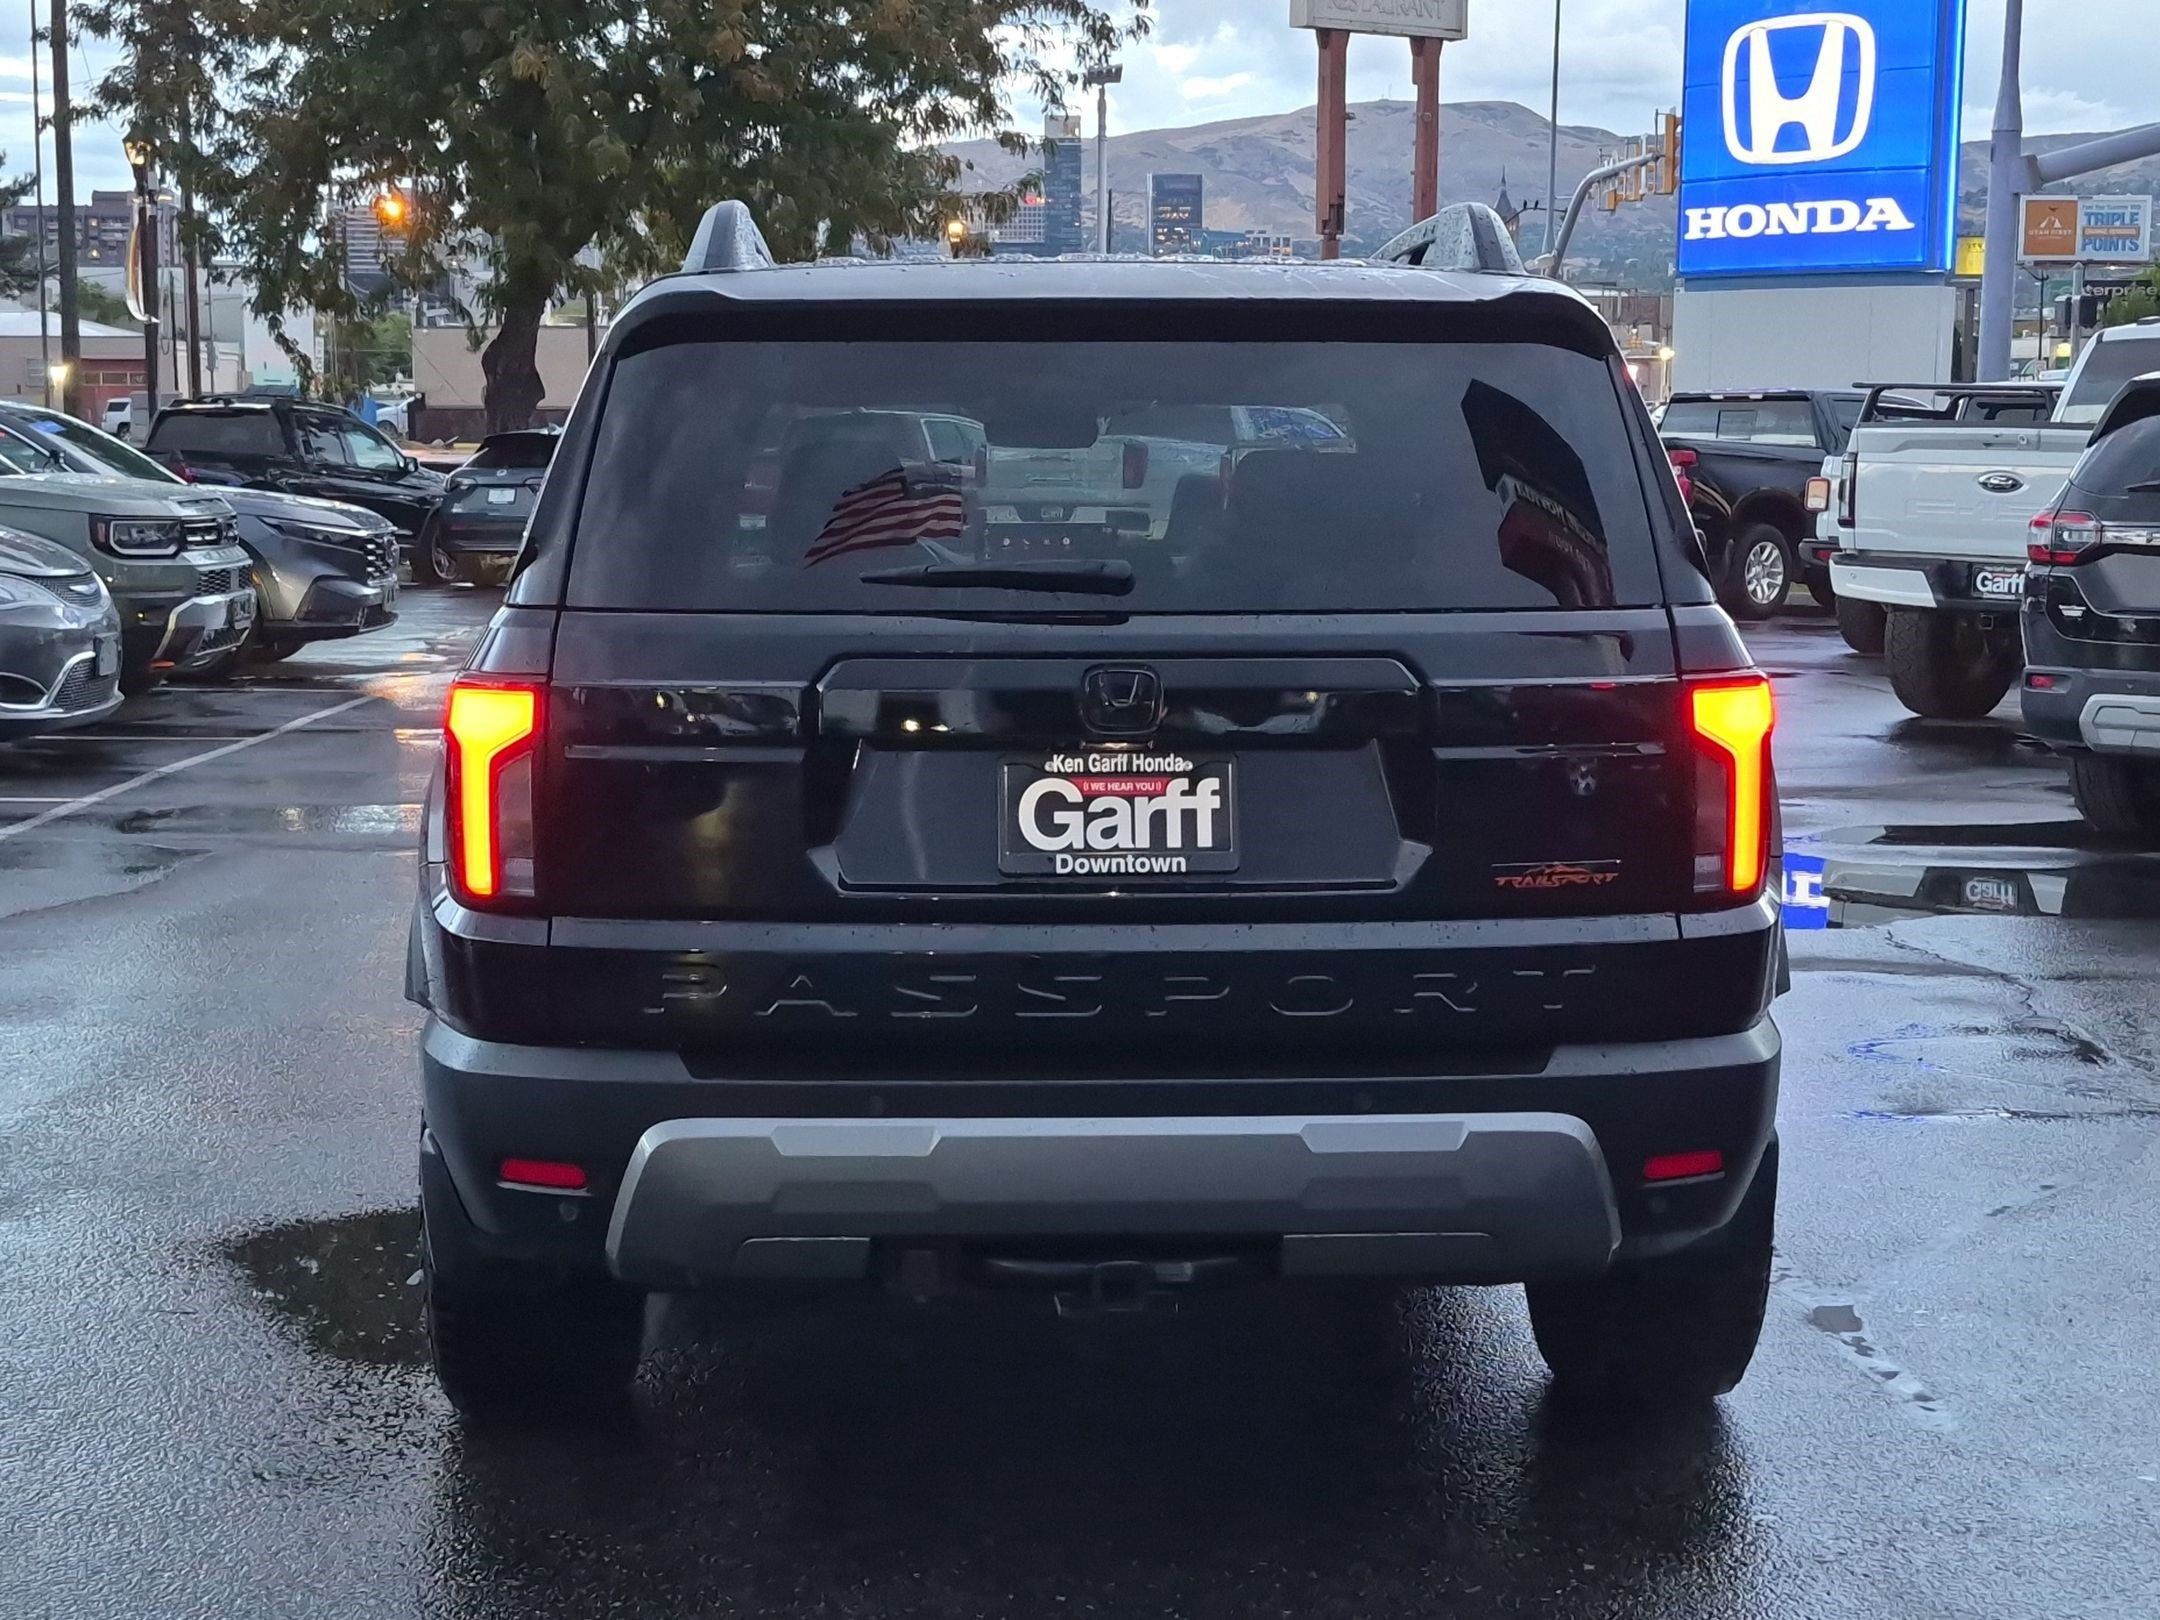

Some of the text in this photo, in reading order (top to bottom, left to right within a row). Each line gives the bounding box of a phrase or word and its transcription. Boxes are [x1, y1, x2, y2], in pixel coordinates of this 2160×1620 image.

[1684, 197, 1915, 240] HONDA
[2084, 211, 2139, 225] TRIPLE
[2081, 238, 2139, 252] POINTS
[1053, 754, 1184, 773] Ken Garff Honda
[1091, 782, 1154, 791] WE HEAR YOU
[1018, 777, 1220, 851] Garff
[1056, 854, 1186, 874] Downtown
[1494, 873, 1619, 888] TRAILSPORT
[642, 964, 1597, 1017] PASSPORT
